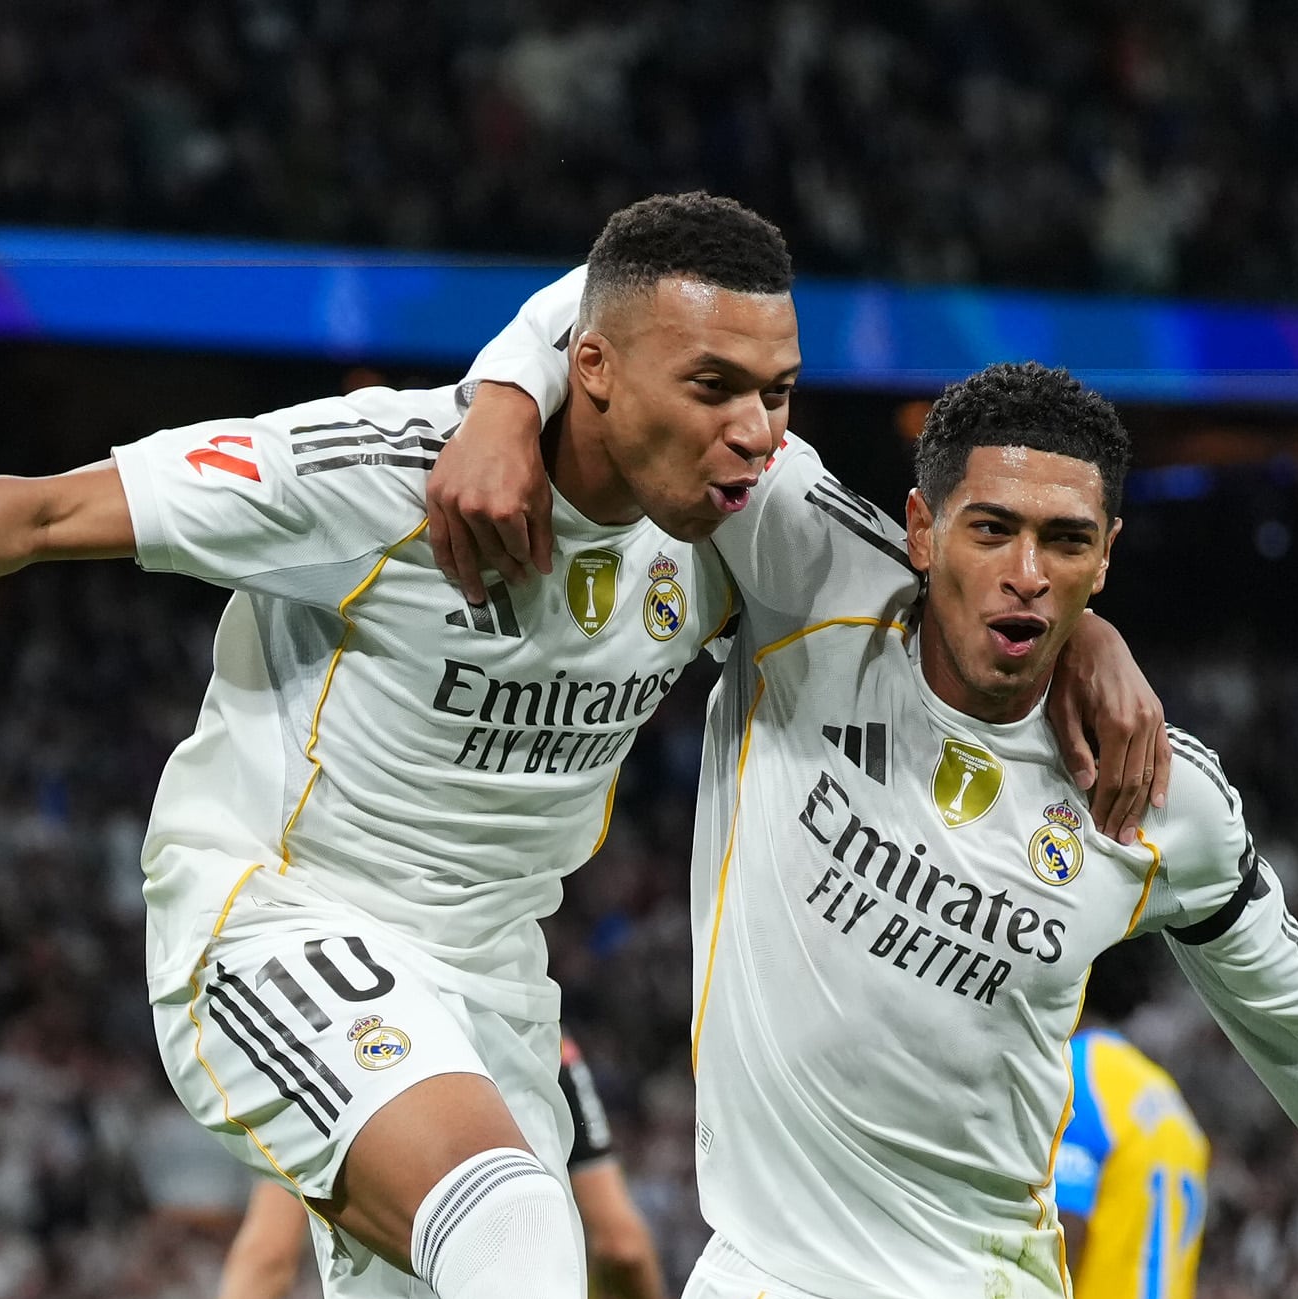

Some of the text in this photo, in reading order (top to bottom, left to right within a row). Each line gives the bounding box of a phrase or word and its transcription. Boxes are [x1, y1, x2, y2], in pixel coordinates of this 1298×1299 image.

[432, 658, 676, 727] Emirates
[453, 727, 635, 774] FLY BETTER
[798, 770, 1067, 964] Emirates
[806, 866, 1012, 1005] FLY BETTER
[254, 936, 396, 1034] 10
